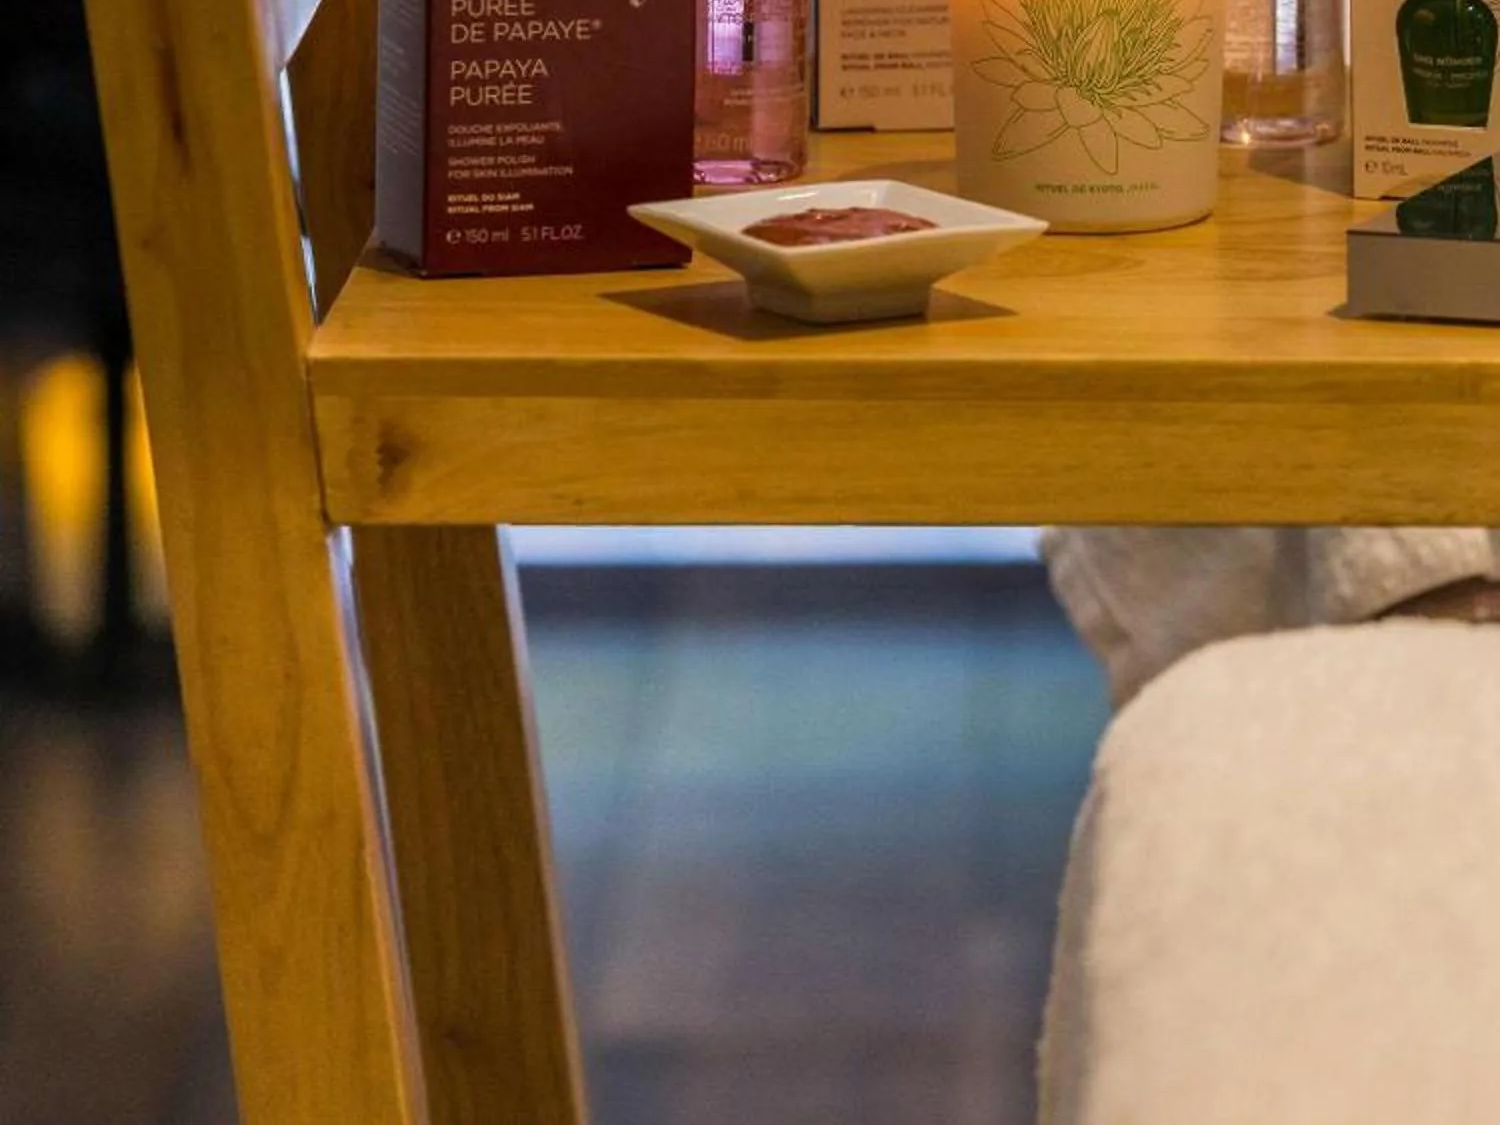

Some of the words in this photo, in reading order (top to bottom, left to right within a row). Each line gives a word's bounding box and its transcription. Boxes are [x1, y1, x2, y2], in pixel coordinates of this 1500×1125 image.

[451, 23, 486, 44] DE
[451, 58, 549, 80] PAPAYA
[451, 81, 534, 107] PURÉE
